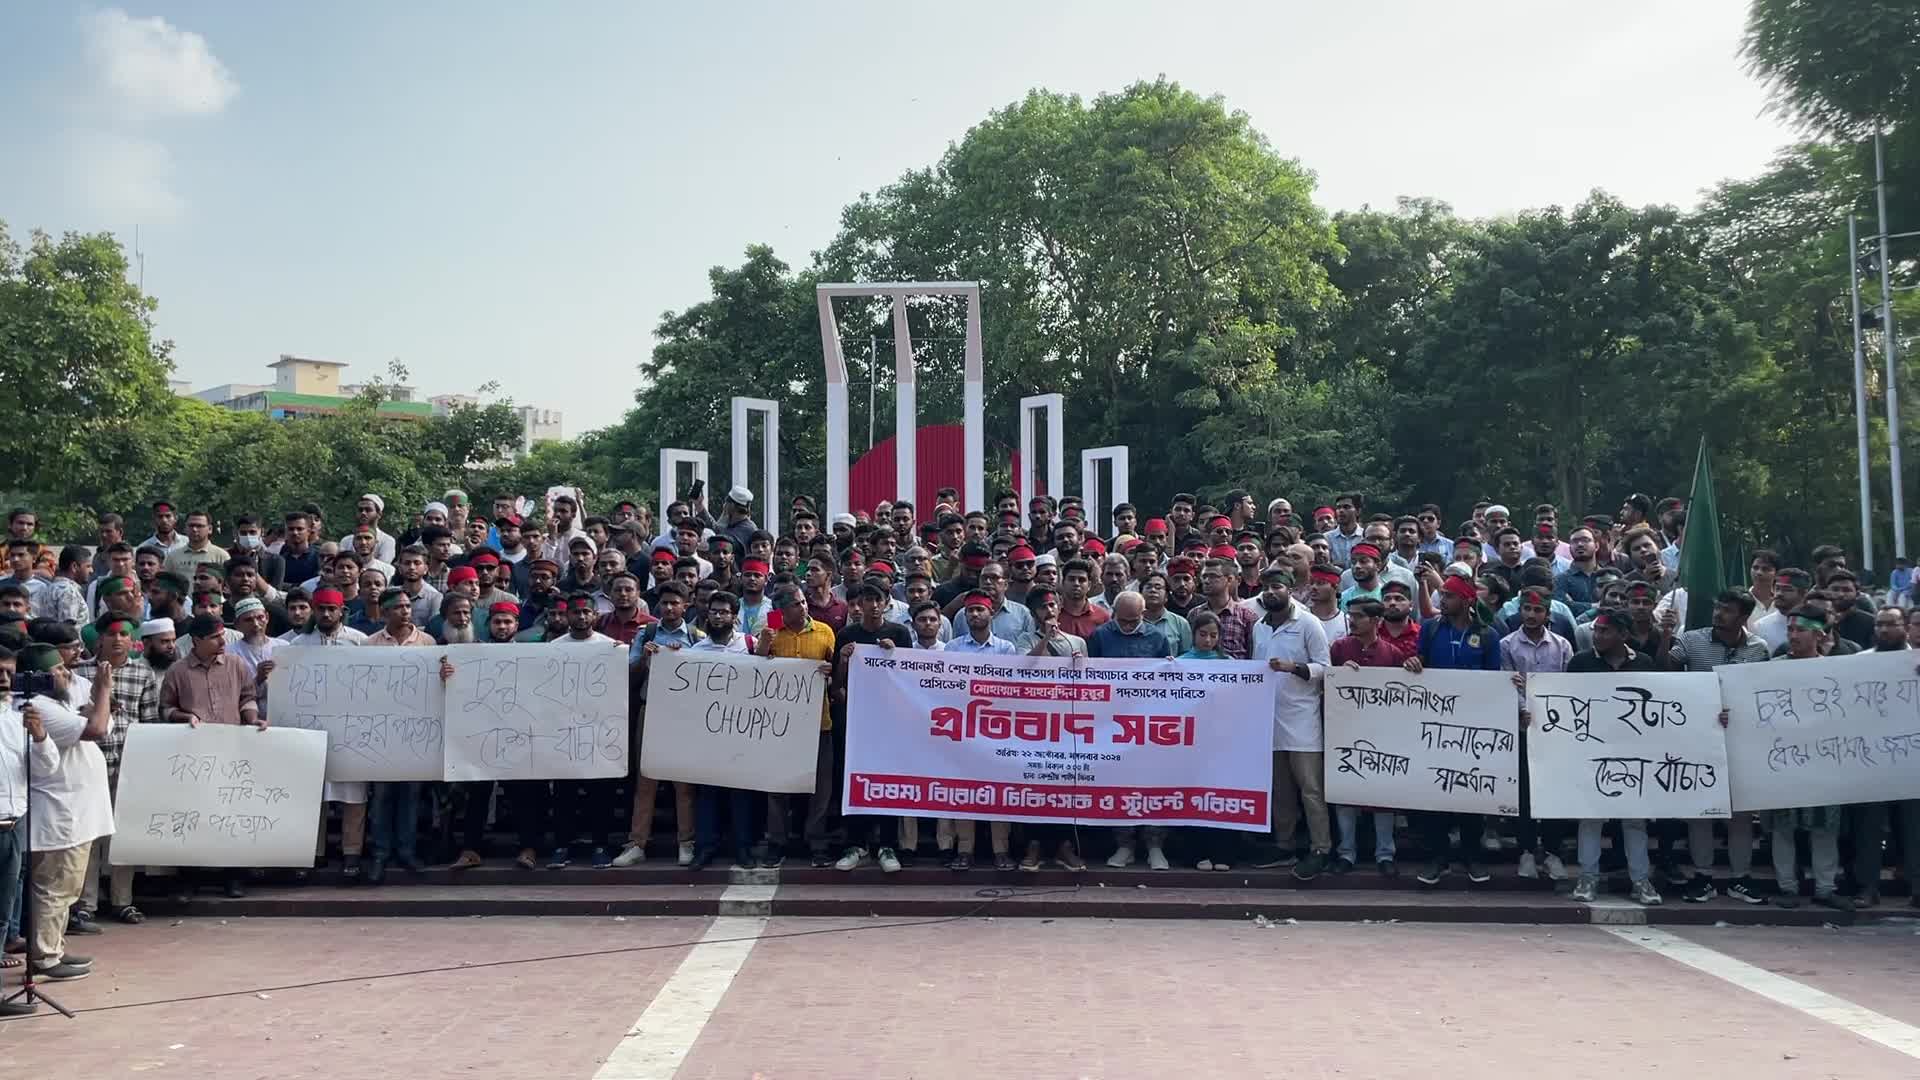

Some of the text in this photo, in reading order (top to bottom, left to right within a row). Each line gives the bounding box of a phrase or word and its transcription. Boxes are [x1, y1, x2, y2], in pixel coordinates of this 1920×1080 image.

[668, 661, 822, 704] STEP DOWN
[864, 656, 897, 670] সাবেক
[900, 660, 945, 674] প্রধানমন্ত্রী
[948, 664, 970, 676] শেখ
[973, 664, 1013, 678] হাসিনার
[1016, 668, 1055, 680] পদত্যাগ
[1058, 667, 1081, 680] নিয়ে
[1085, 668, 1128, 682] মিথ্যাচার
[1132, 671, 1155, 681] করে
[1158, 671, 1184, 683] শপথ
[1208, 673, 1237, 684] করার
[1240, 673, 1264, 684] দায়ে
[919, 676, 967, 691] প্রেসিডেন্ট
[1116, 687, 1167, 699] পদত্যাগের
[1170, 687, 1206, 700] দাবিতে
[705, 701, 790, 740] CHUPPU
[930, 699, 1195, 746] প্রতিবাদ সভা
[1535, 687, 1687, 743] চুপ্পু হটাও
[1421, 721, 1514, 760] দালালেরা
[856, 775, 1256, 817] বৈষম্য বিরোধী চিকিৎসক ও স্টুডেন্ট পরিষদ
[1588, 752, 1716, 798] দেশ বাঁচাও
